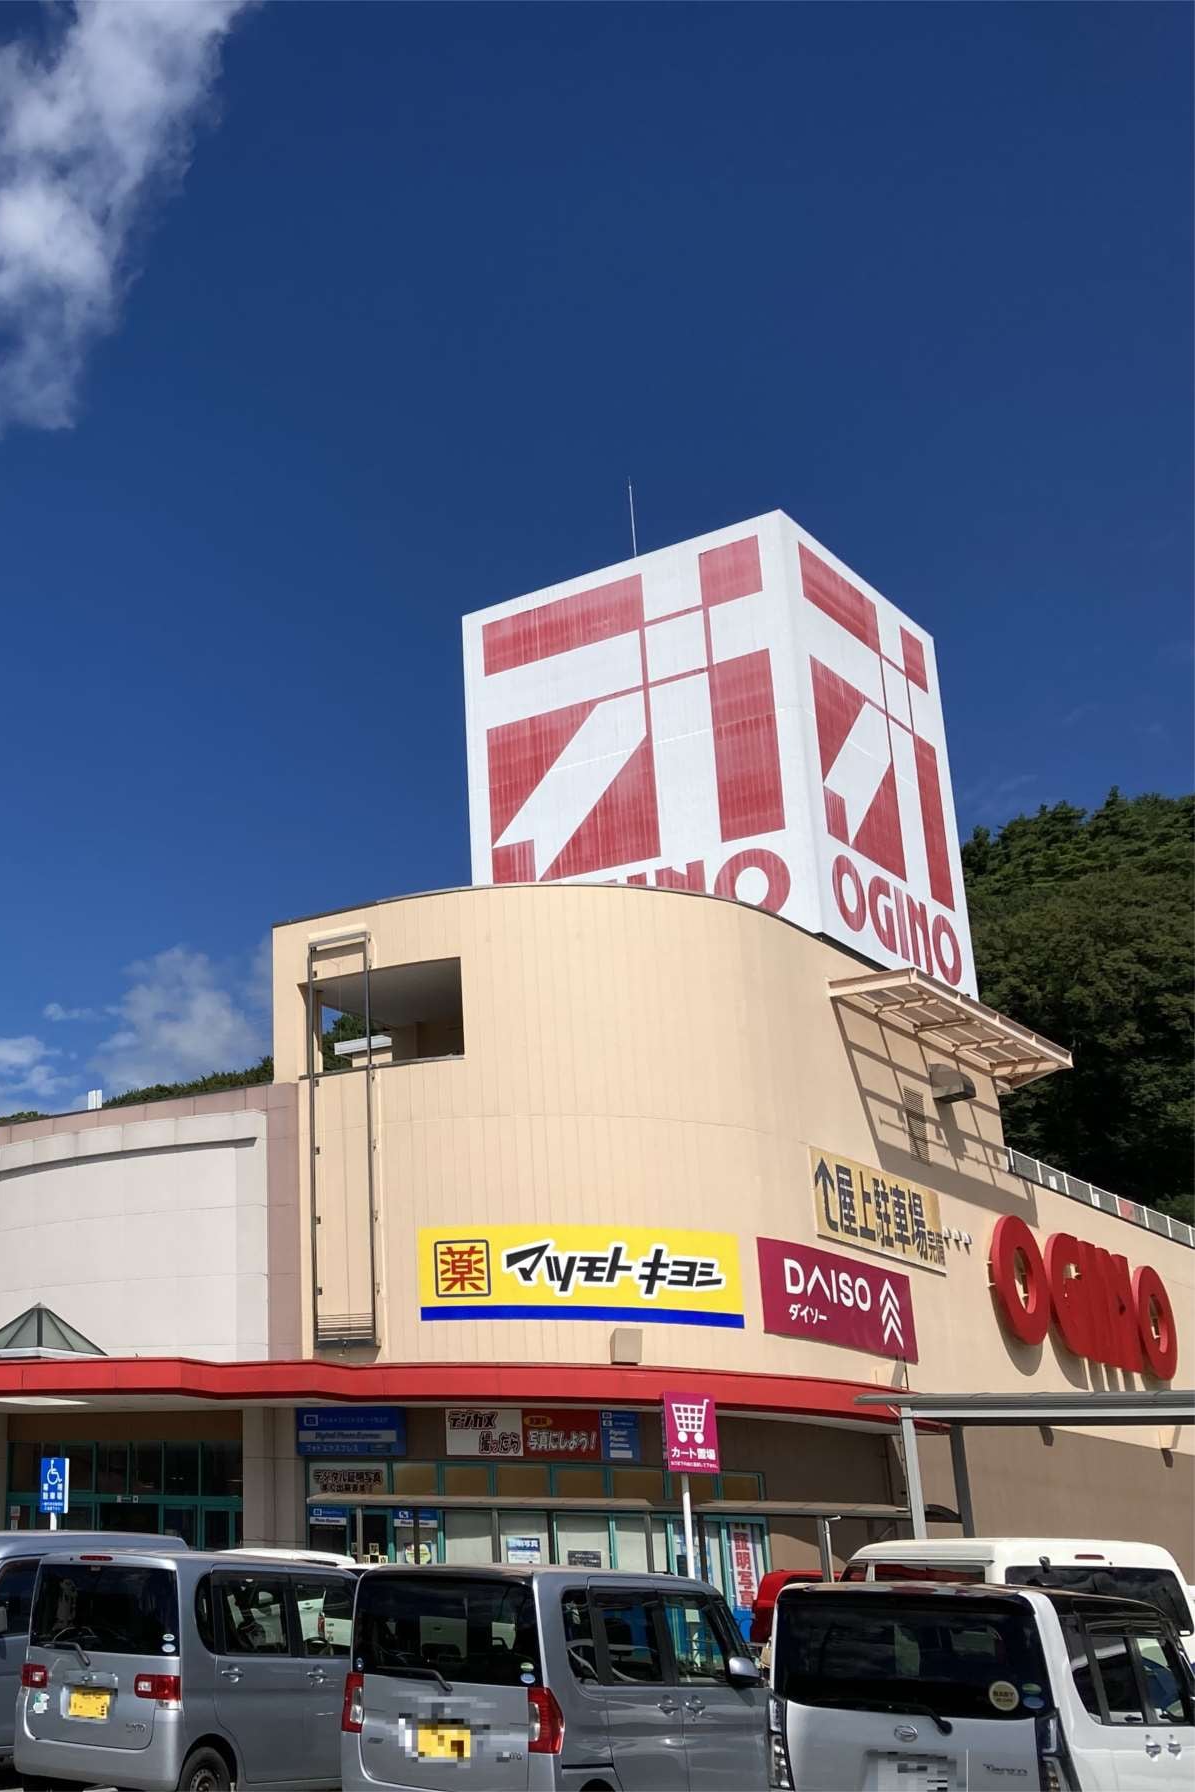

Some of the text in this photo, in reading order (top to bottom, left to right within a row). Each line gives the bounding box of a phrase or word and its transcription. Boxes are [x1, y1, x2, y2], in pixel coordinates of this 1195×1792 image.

[832, 854, 963, 986] OGINO
[439, 1245, 485, 1293] 薬
[505, 1243, 724, 1295] マツモトキヨシ
[783, 1258, 872, 1313] DAISO
[789, 1303, 828, 1325] ダイソー
[990, 1215, 1178, 1381] OGINO
[448, 1411, 498, 1430] デジカメ
